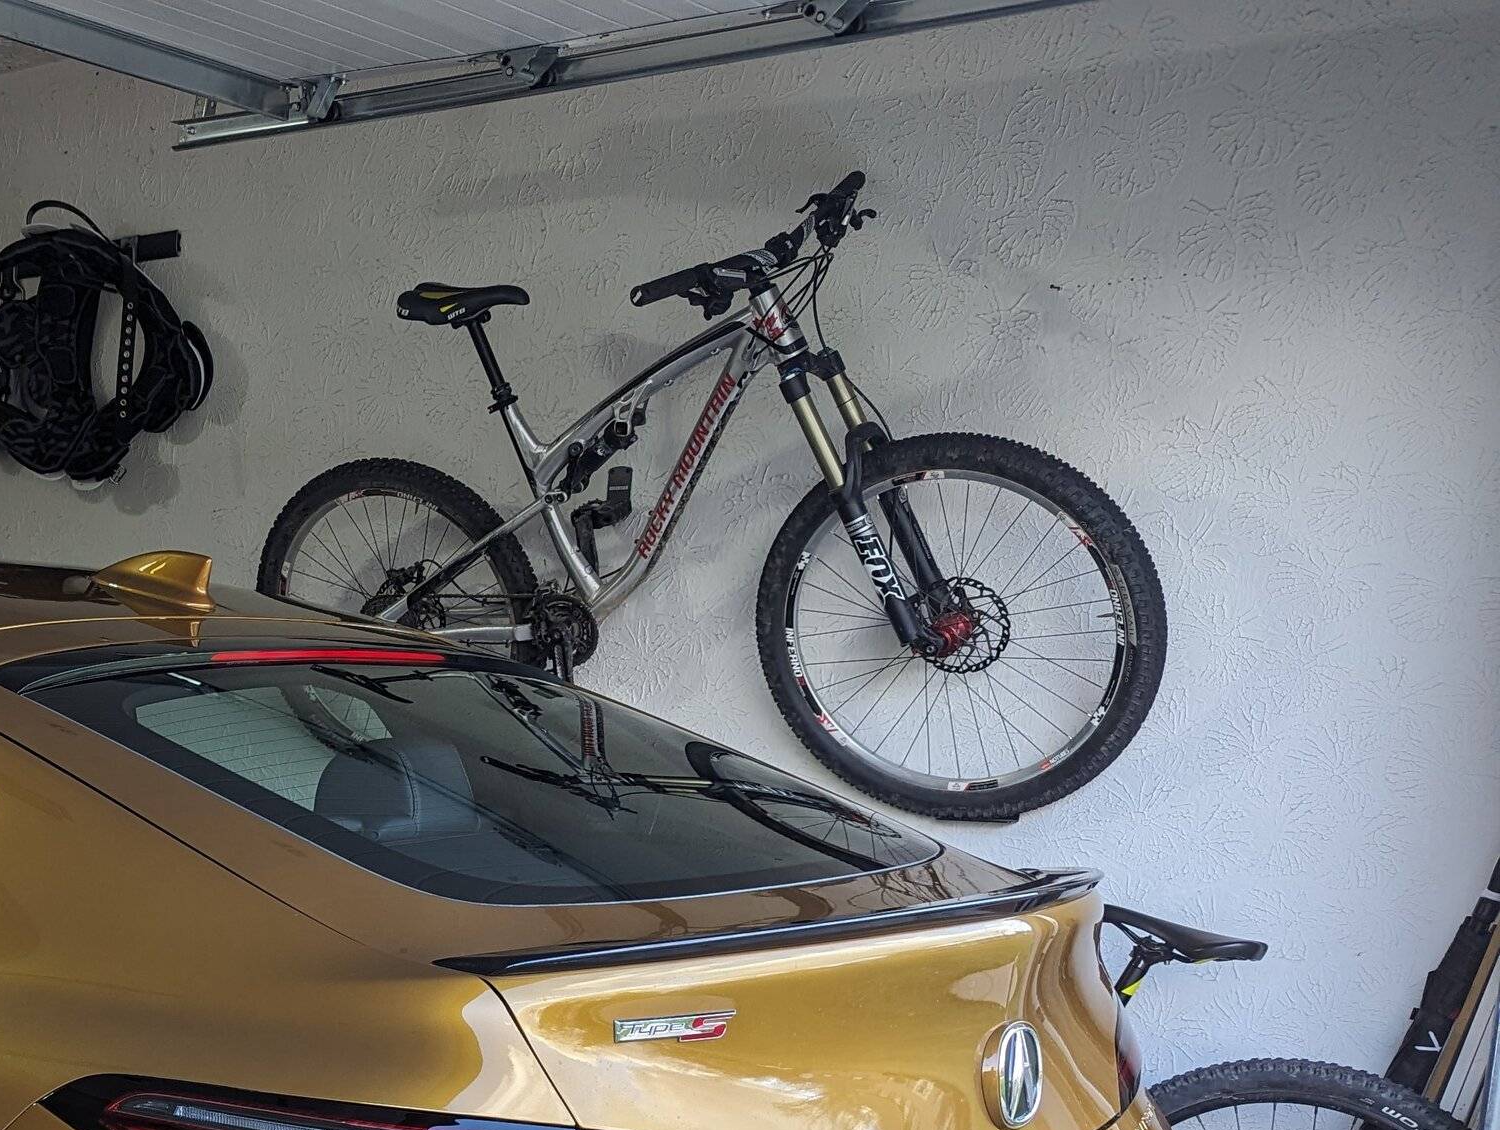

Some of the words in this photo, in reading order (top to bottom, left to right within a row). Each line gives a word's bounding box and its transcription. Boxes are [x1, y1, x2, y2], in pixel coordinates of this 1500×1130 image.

[637, 489, 676, 561] ROCKY
[672, 372, 738, 488] MOUNTAIN
[854, 536, 906, 606] FOX
[1109, 589, 1125, 646] INFERNO
[785, 627, 803, 677] INFERNO
[628, 1022, 682, 1036] Type
[679, 1009, 737, 1042] S
